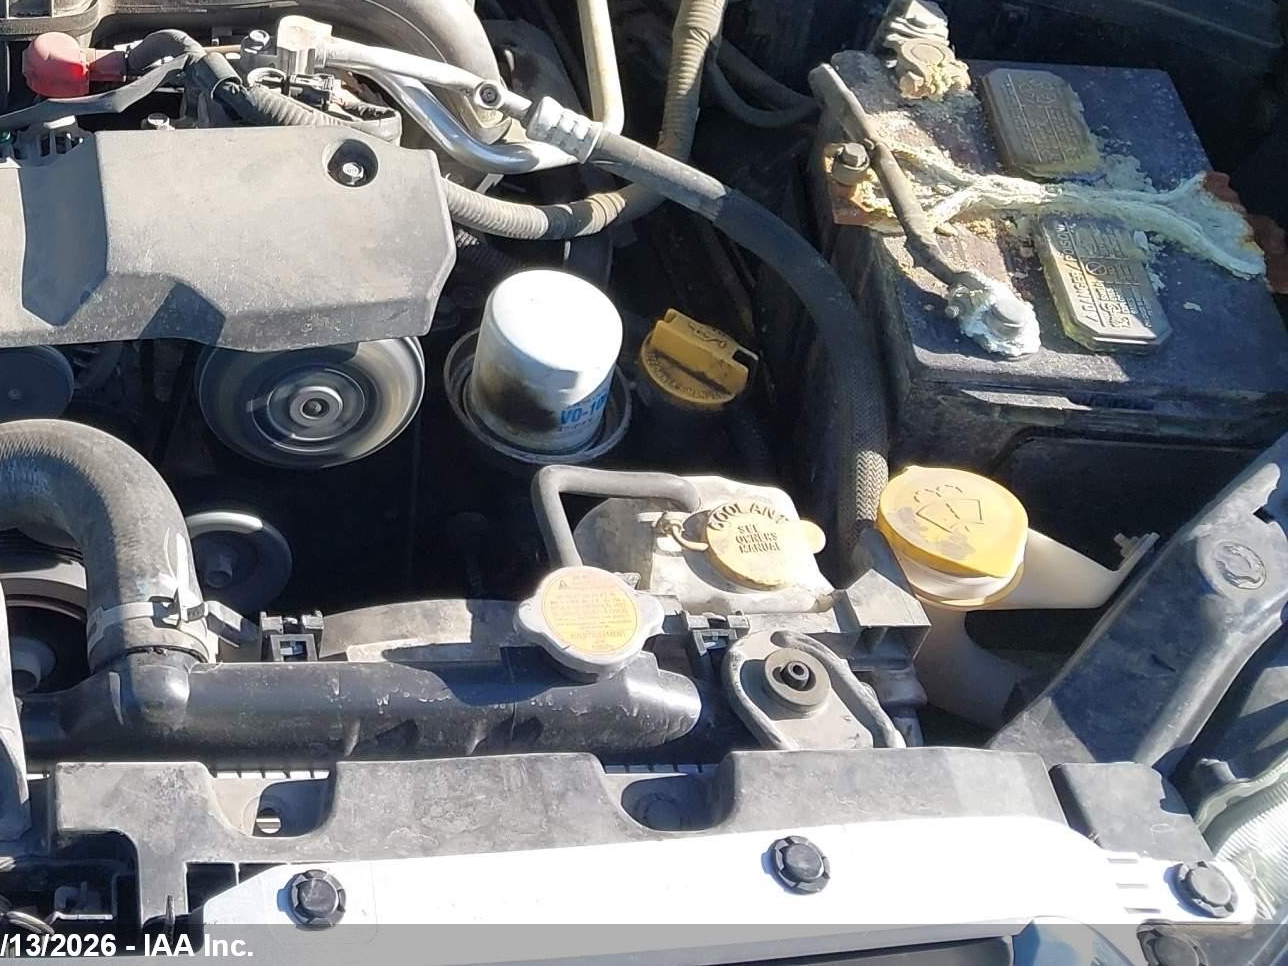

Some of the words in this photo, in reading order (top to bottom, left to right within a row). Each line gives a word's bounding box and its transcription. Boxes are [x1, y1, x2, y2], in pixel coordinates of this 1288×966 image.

[707, 502, 789, 531] COOLANT
[737, 524, 759, 534] SEE
[738, 543, 781, 554] MANUAL
